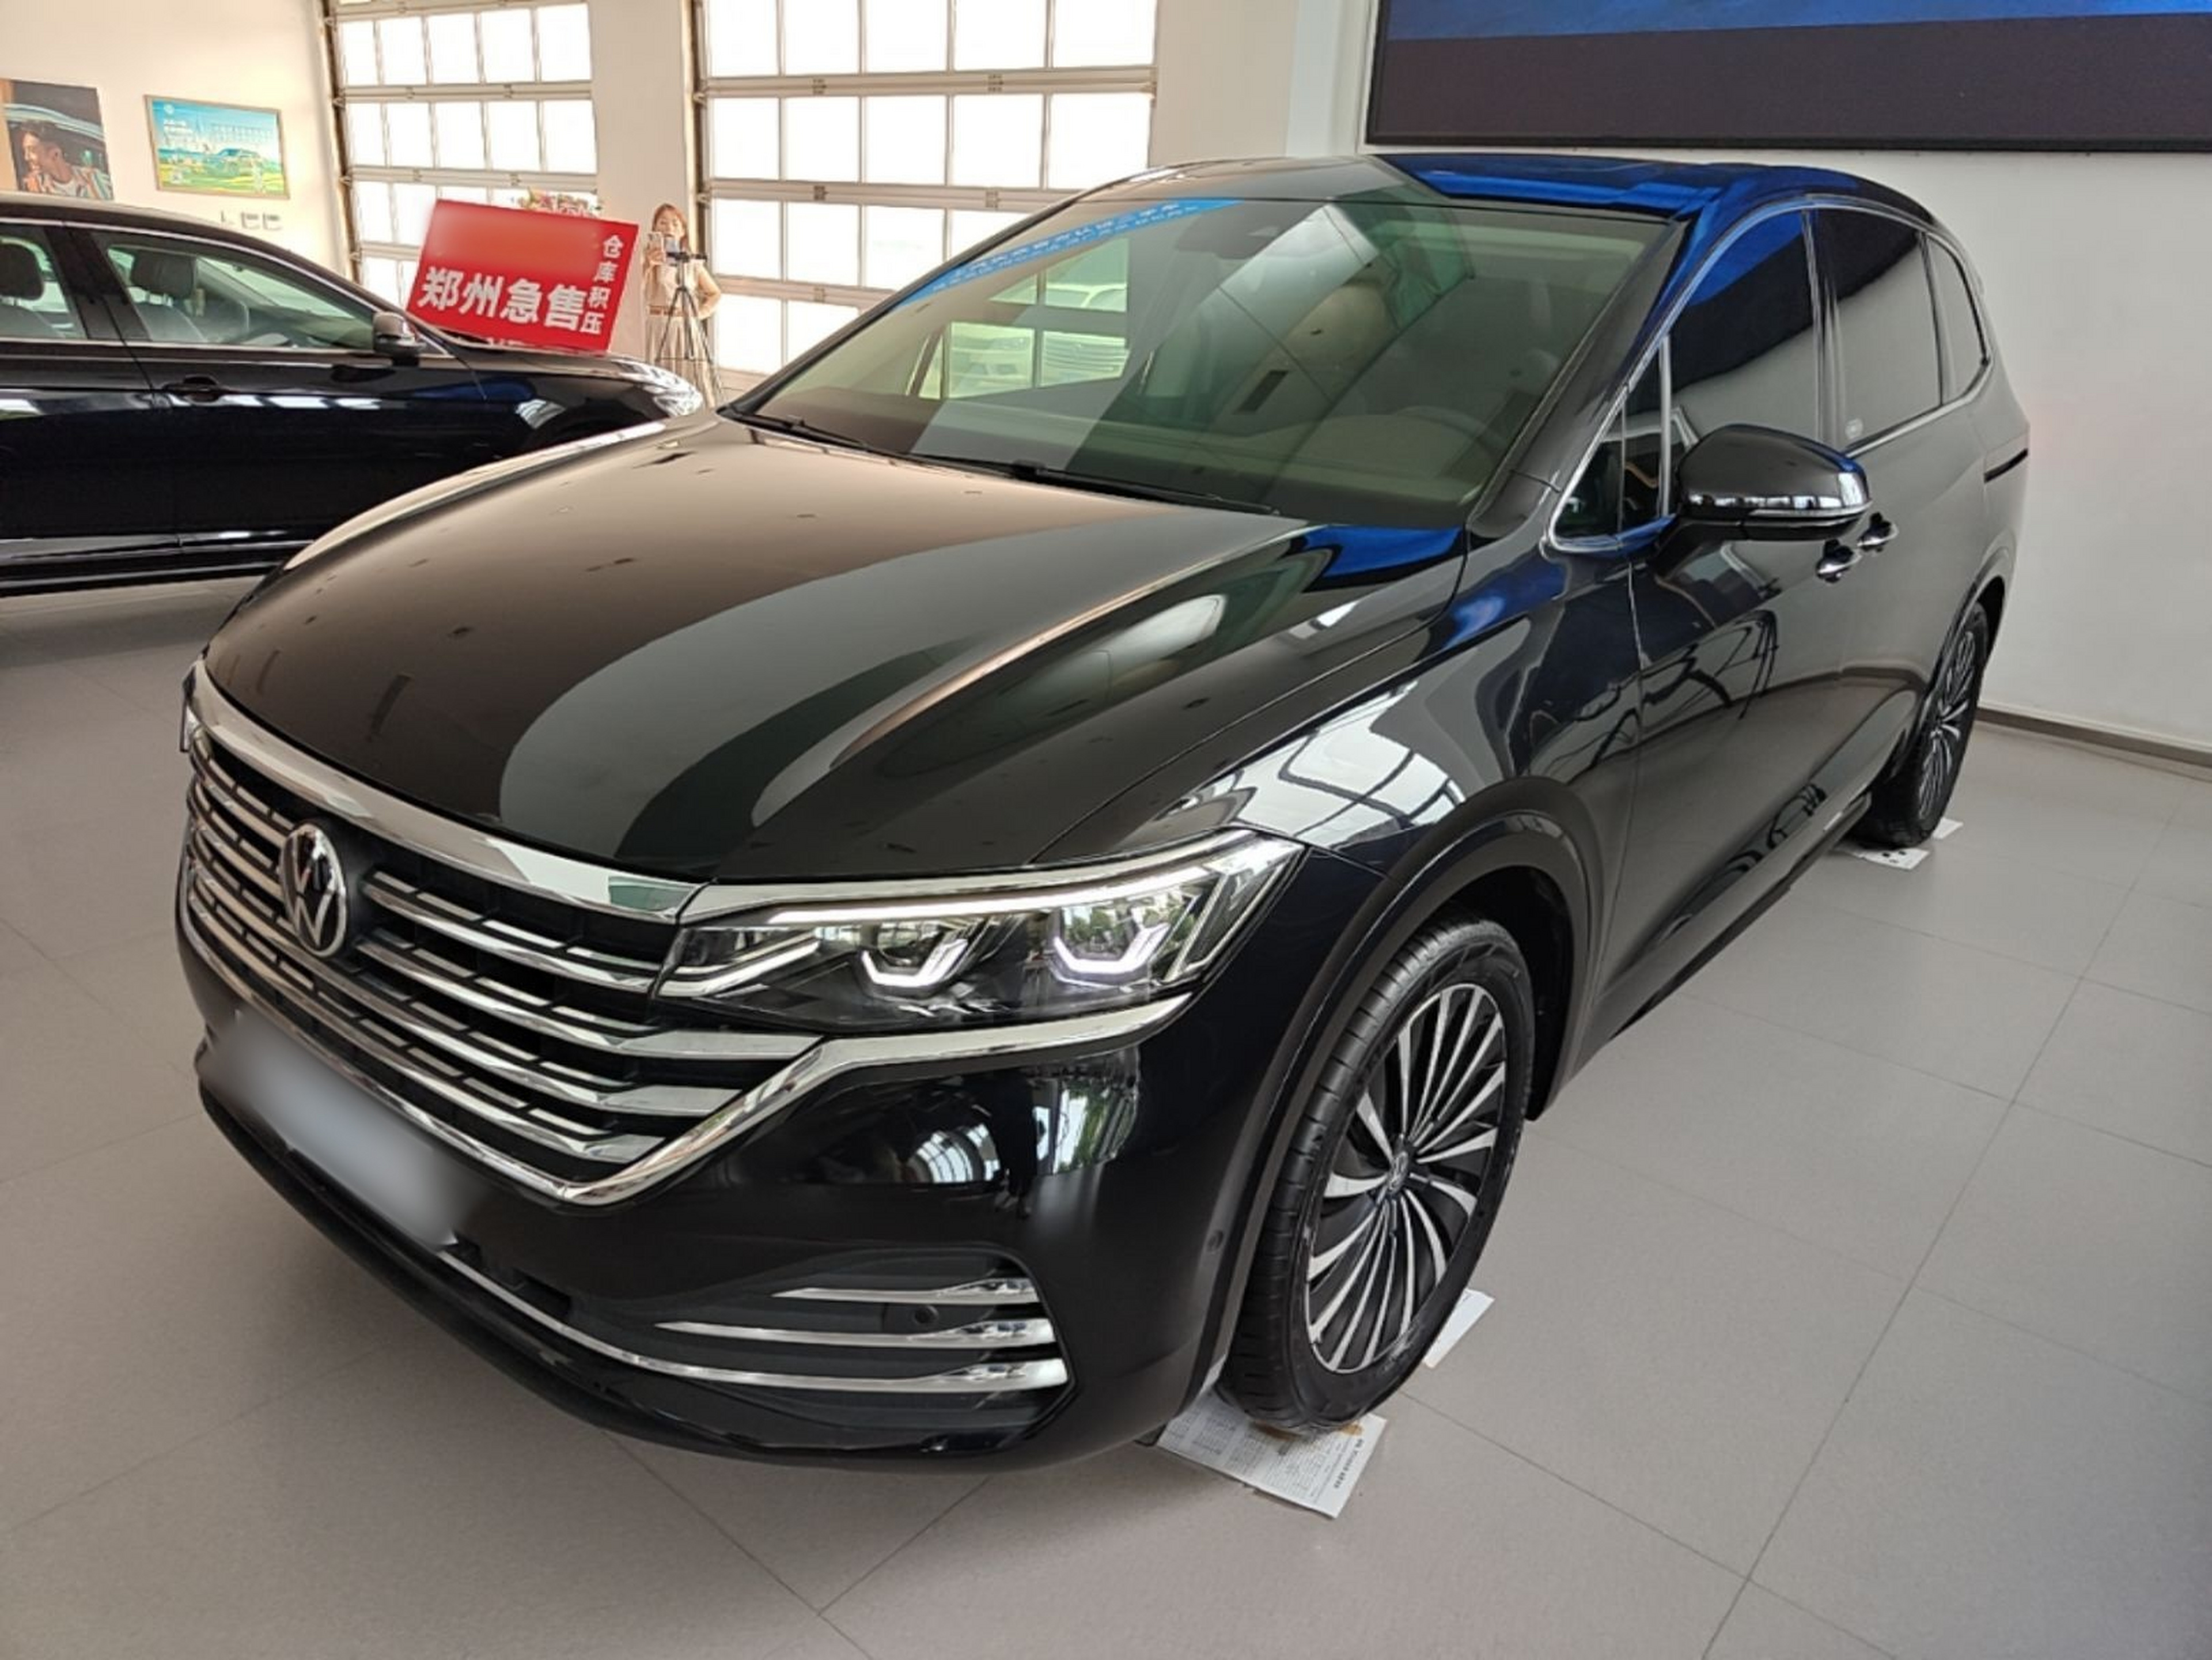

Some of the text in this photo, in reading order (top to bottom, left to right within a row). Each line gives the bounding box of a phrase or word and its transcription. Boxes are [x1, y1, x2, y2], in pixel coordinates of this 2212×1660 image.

[417, 266, 587, 330] 郑州急售
[579, 235, 624, 335] 仓库积压
